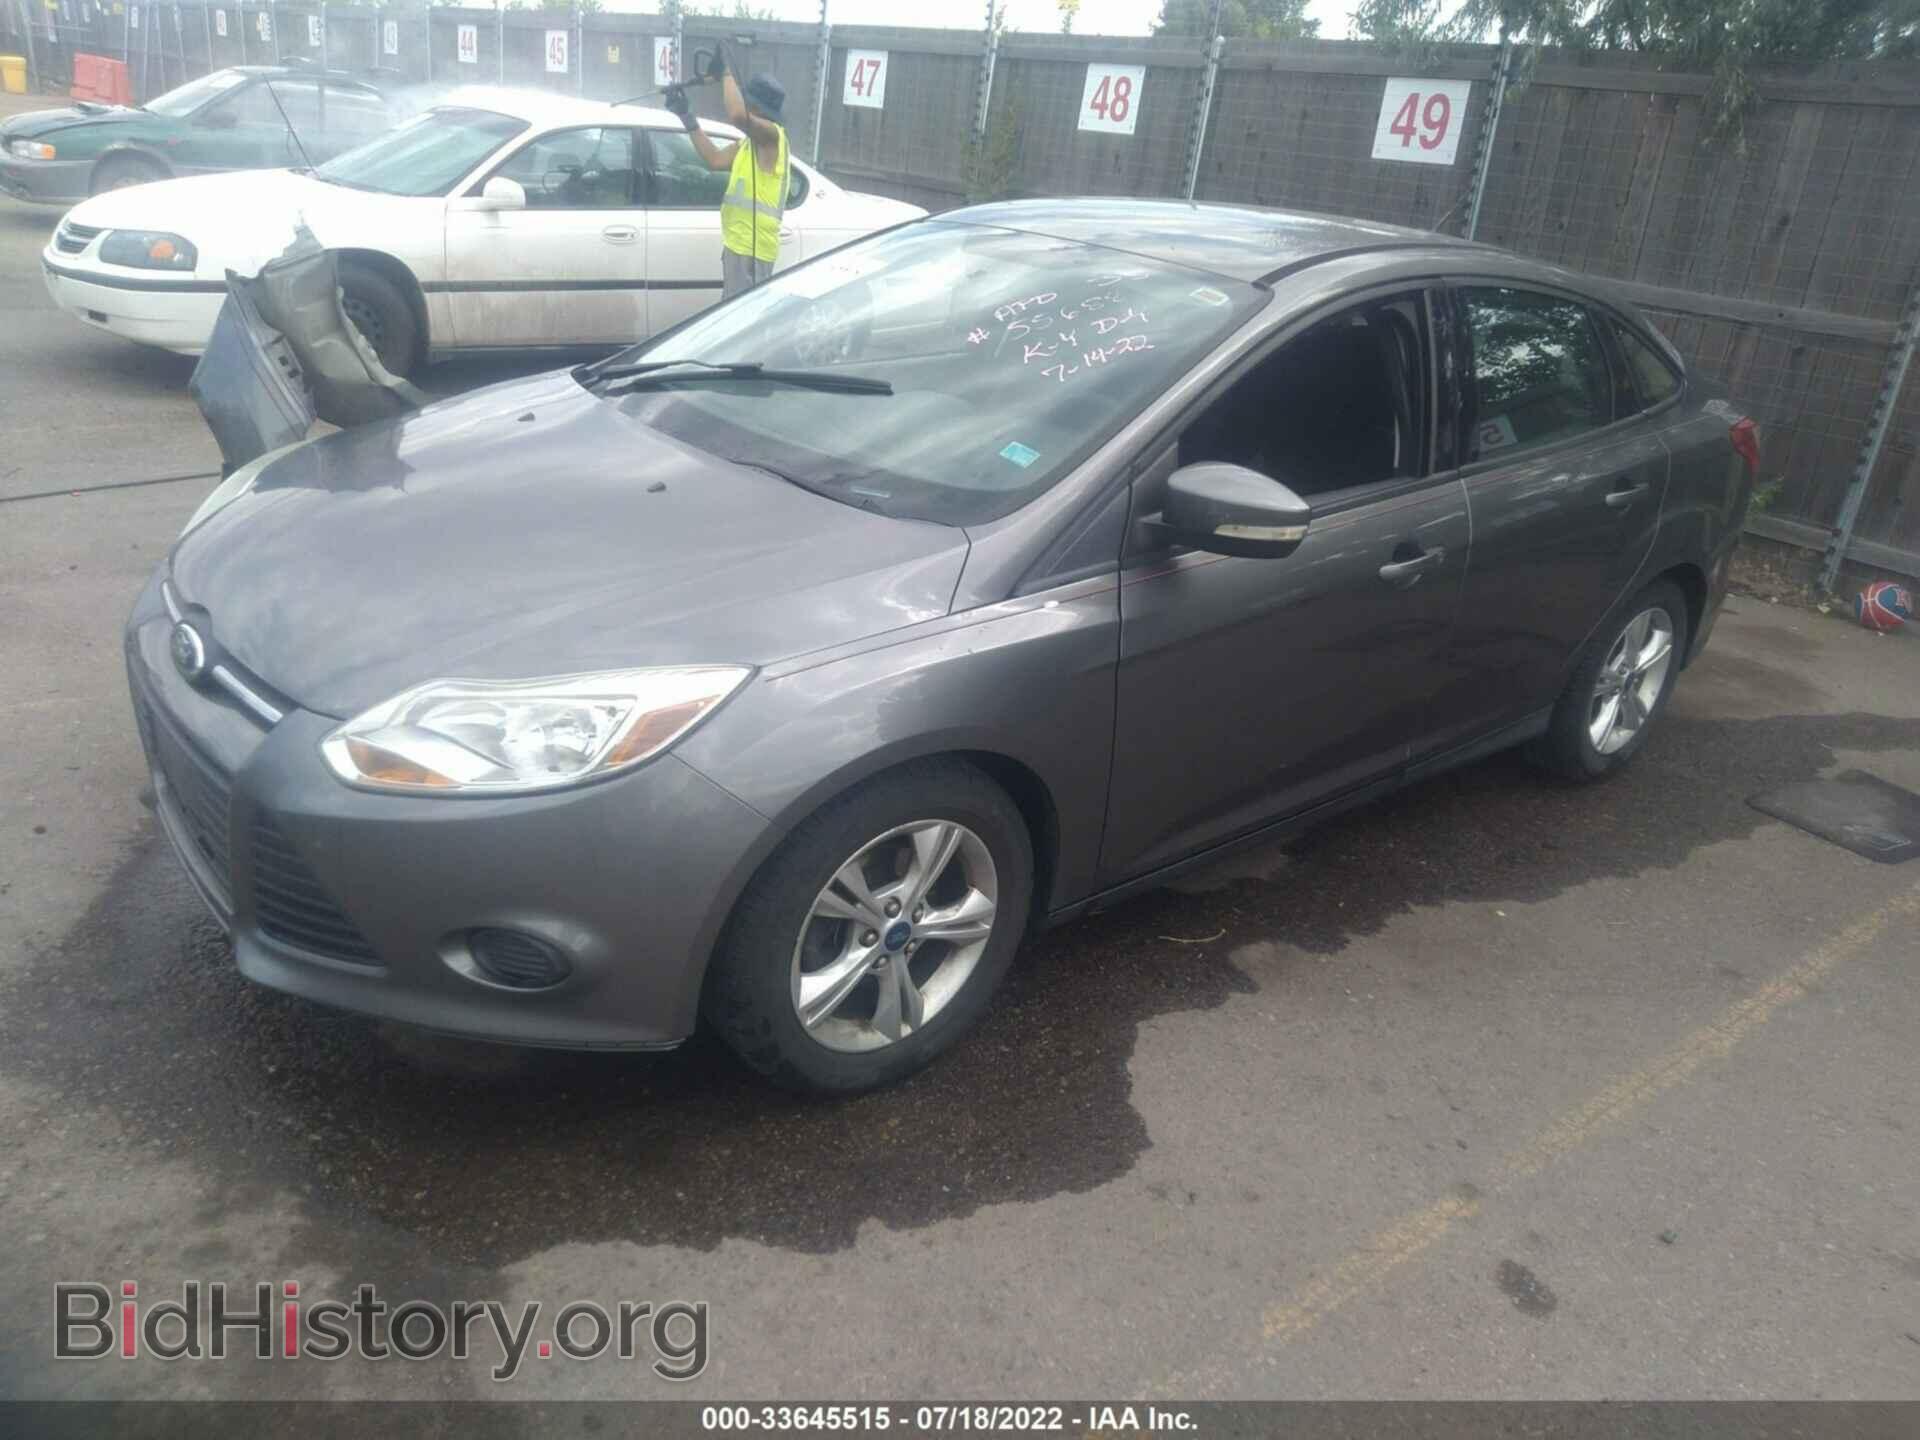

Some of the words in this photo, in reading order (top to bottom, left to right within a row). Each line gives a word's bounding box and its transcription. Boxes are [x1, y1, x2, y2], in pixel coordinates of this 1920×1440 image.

[549, 36, 564, 65] 45
[851, 58, 881, 97] 47
[1090, 75, 1133, 122] 48
[1391, 92, 1451, 150] 49
[1041, 335, 1155, 382] 7-14-22
